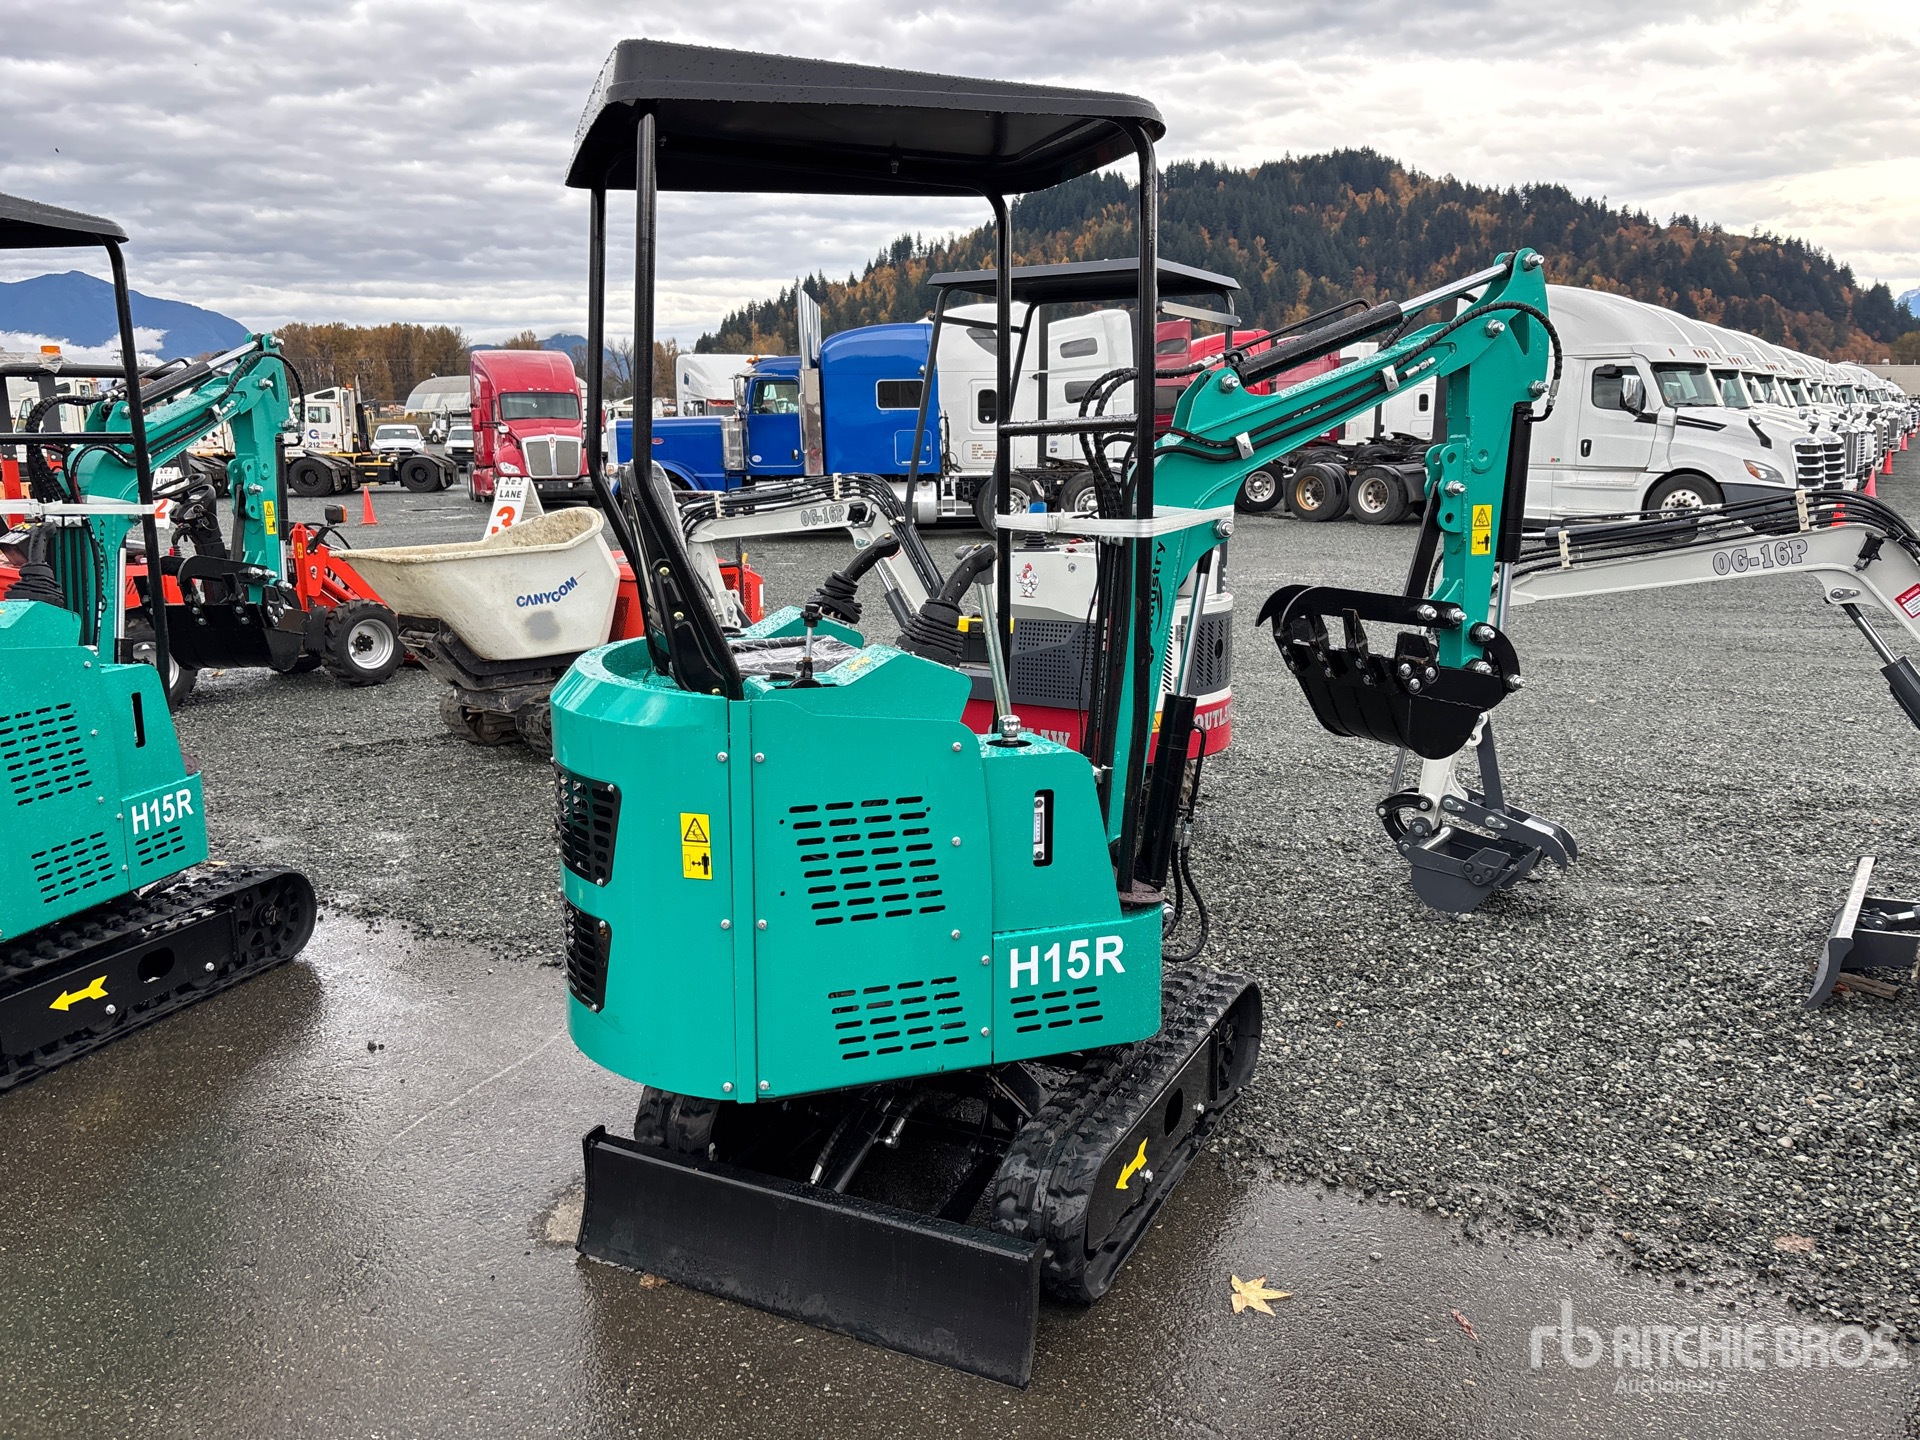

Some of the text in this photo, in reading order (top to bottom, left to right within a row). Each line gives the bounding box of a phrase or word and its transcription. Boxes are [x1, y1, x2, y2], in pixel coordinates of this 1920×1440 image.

[499, 490, 523, 499] LANE
[1712, 538, 1808, 576] OG-16P
[516, 575, 579, 608] CANYCOM
[131, 788, 194, 835] H15R
[1009, 934, 1126, 990] H15R
